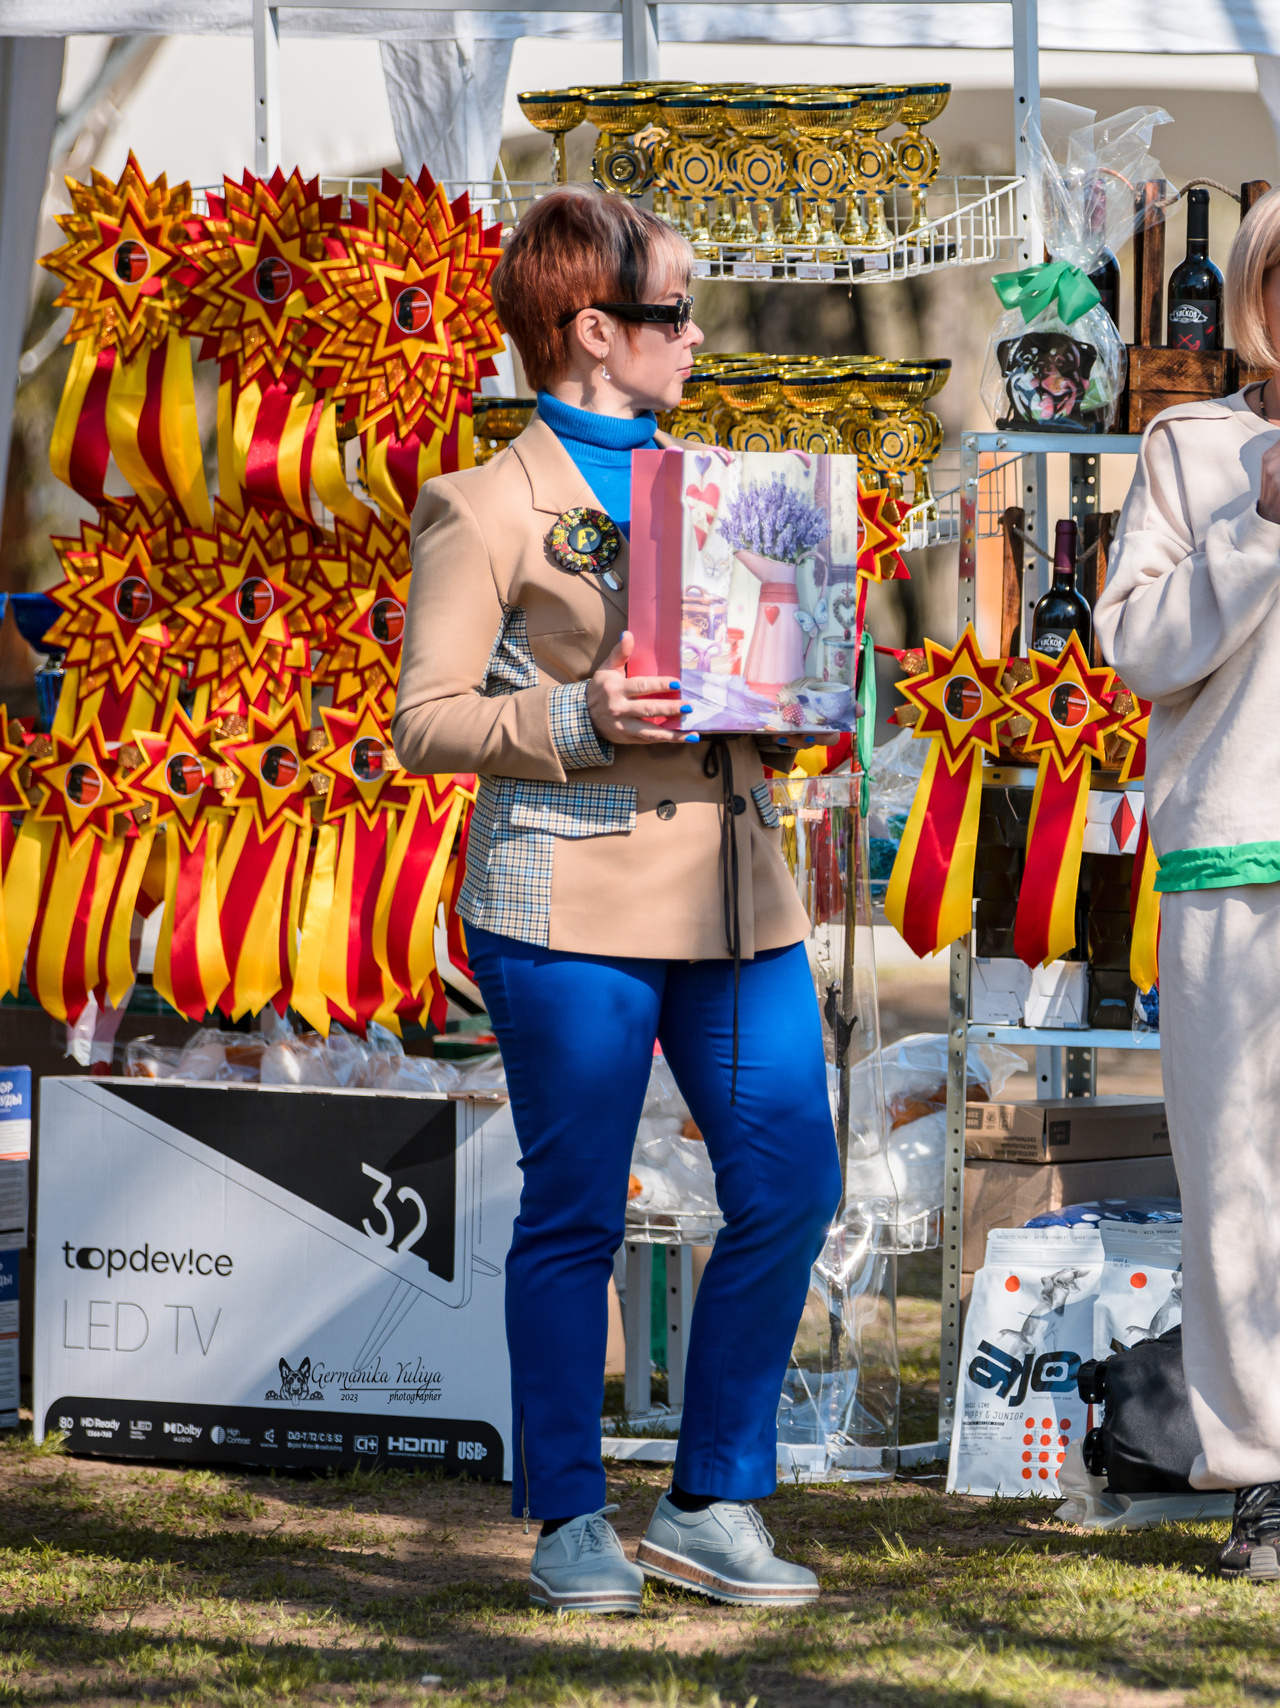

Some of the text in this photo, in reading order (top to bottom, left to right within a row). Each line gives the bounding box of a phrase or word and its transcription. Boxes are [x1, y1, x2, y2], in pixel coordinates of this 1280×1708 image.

[361, 1162, 428, 1255] 32
[63, 1300, 222, 1356] LED TV
[964, 1411, 1024, 1420] PUPPY & JUNIOR
[58, 1416, 74, 1429] 80
[80, 1417, 120, 1432] HD Ready
[130, 1420, 152, 1431] LED
[176, 1421, 202, 1438] Dolby
[226, 1428, 240, 1437] High
[173, 1436, 193, 1444] AUDIO
[226, 1436, 251, 1445] Contrast
[388, 1436, 445, 1454] HDMI
[315, 1444, 343, 1452] Broadcasting
[457, 1440, 482, 1461] USB
